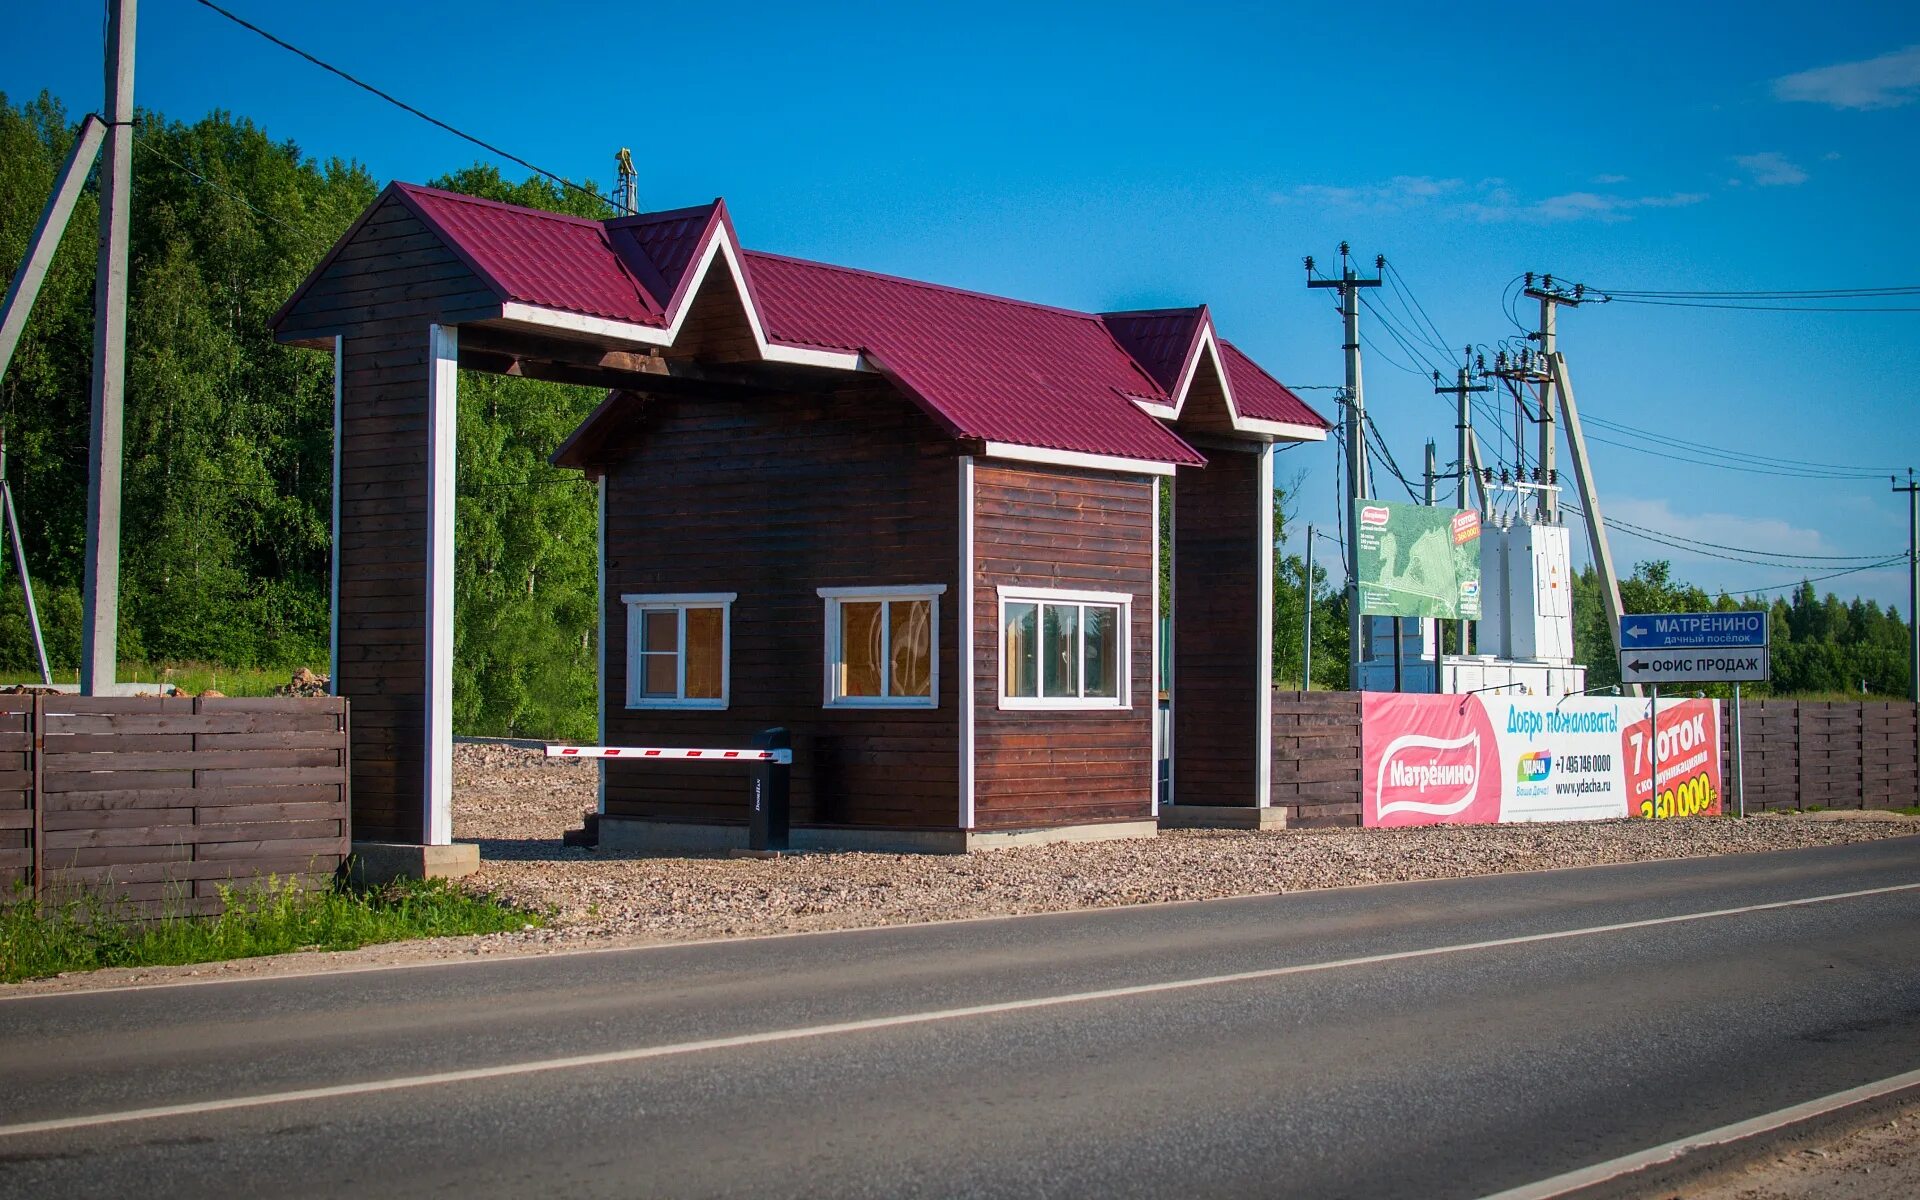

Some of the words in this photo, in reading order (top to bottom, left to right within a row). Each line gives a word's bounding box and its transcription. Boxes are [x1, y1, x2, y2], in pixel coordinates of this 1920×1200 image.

[1656, 615, 1759, 633] МАТРЁНИНО
[1664, 634, 1704, 645] дачный
[1707, 633, 1750, 643] посёлок
[1652, 659, 1693, 672] ОФИС
[1697, 658, 1758, 672] ПРОДАЖ
[1506, 703, 1543, 742] Добро
[1546, 704, 1618, 734] пожаловать!
[1556, 756, 1565, 773] +7
[1566, 755, 1579, 773] 495
[1579, 755, 1591, 773] 746
[1592, 754, 1611, 772] 0000
[1629, 732, 1643, 776] 7
[1390, 759, 1475, 793] Матрёнино
[1522, 759, 1546, 776] УДАЧА
[1641, 750, 1708, 793] комуникациями
[1556, 778, 1611, 797] www.ydacha.ru
